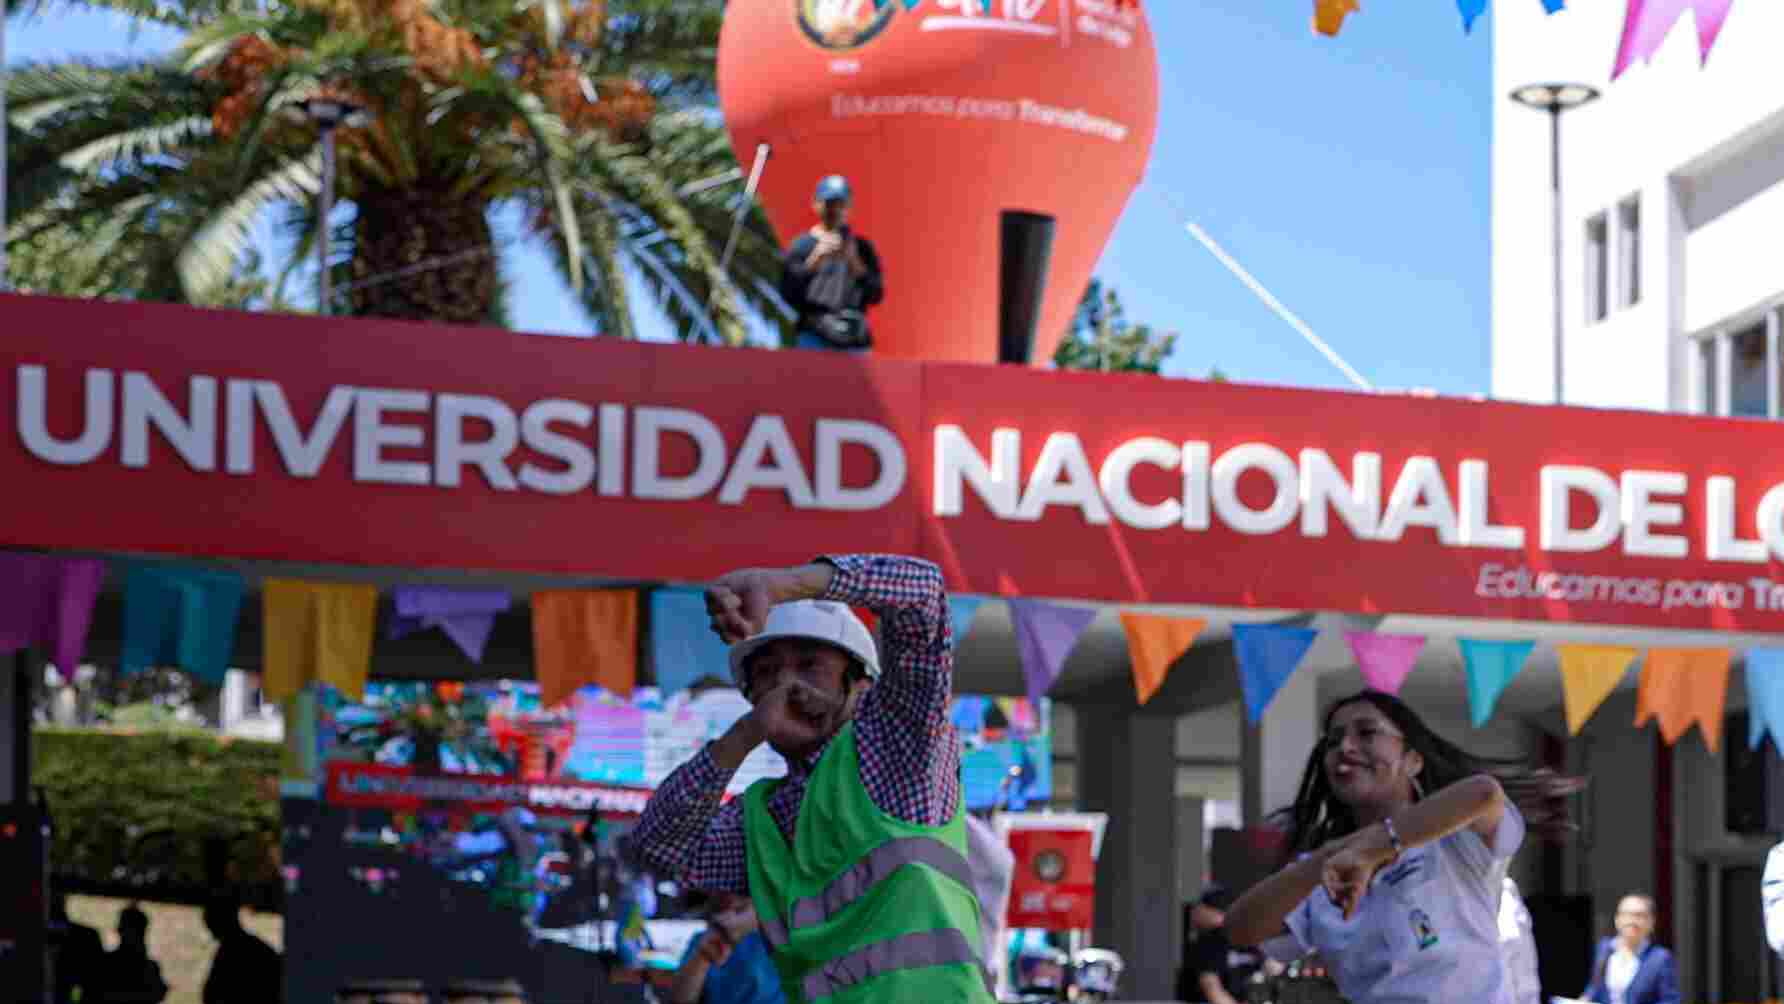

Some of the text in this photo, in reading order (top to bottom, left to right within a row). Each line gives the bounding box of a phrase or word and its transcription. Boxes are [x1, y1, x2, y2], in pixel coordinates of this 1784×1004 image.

[16, 363, 906, 511] UNIVERSIDAD
[932, 424, 1526, 550] NACIONAL
[1539, 464, 1690, 558] DE
[1475, 563, 1661, 602] Educamos
[1661, 576, 1744, 610] para
